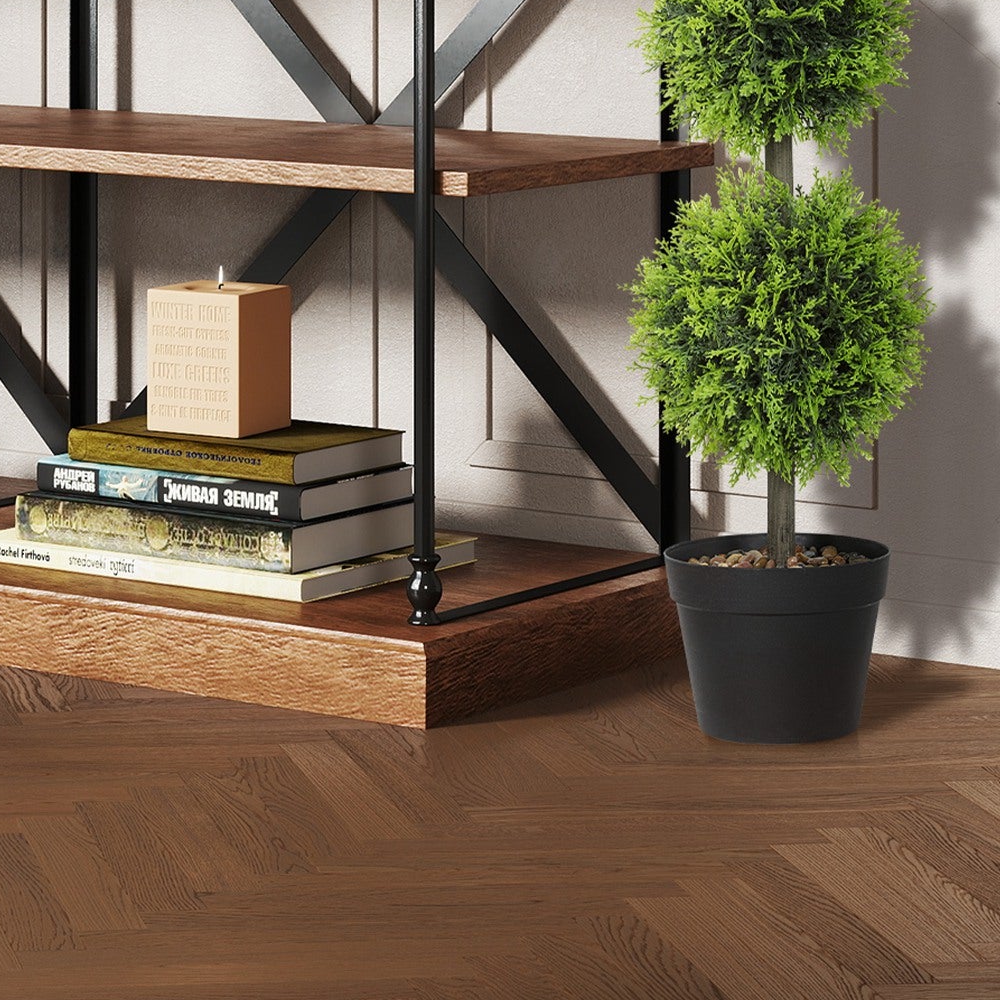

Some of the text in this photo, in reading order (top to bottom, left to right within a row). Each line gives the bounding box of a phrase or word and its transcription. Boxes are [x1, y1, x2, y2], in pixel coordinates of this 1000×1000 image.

[151, 301, 231, 323] WINTER HOME
[184, 364, 231, 384] GREENS
[185, 451, 261, 466] ГЕОЛОГИЧЕСКОЕ
[53, 467, 95, 483] АНДРЕЙ
[53, 479, 96, 493] РУБАНОВ
